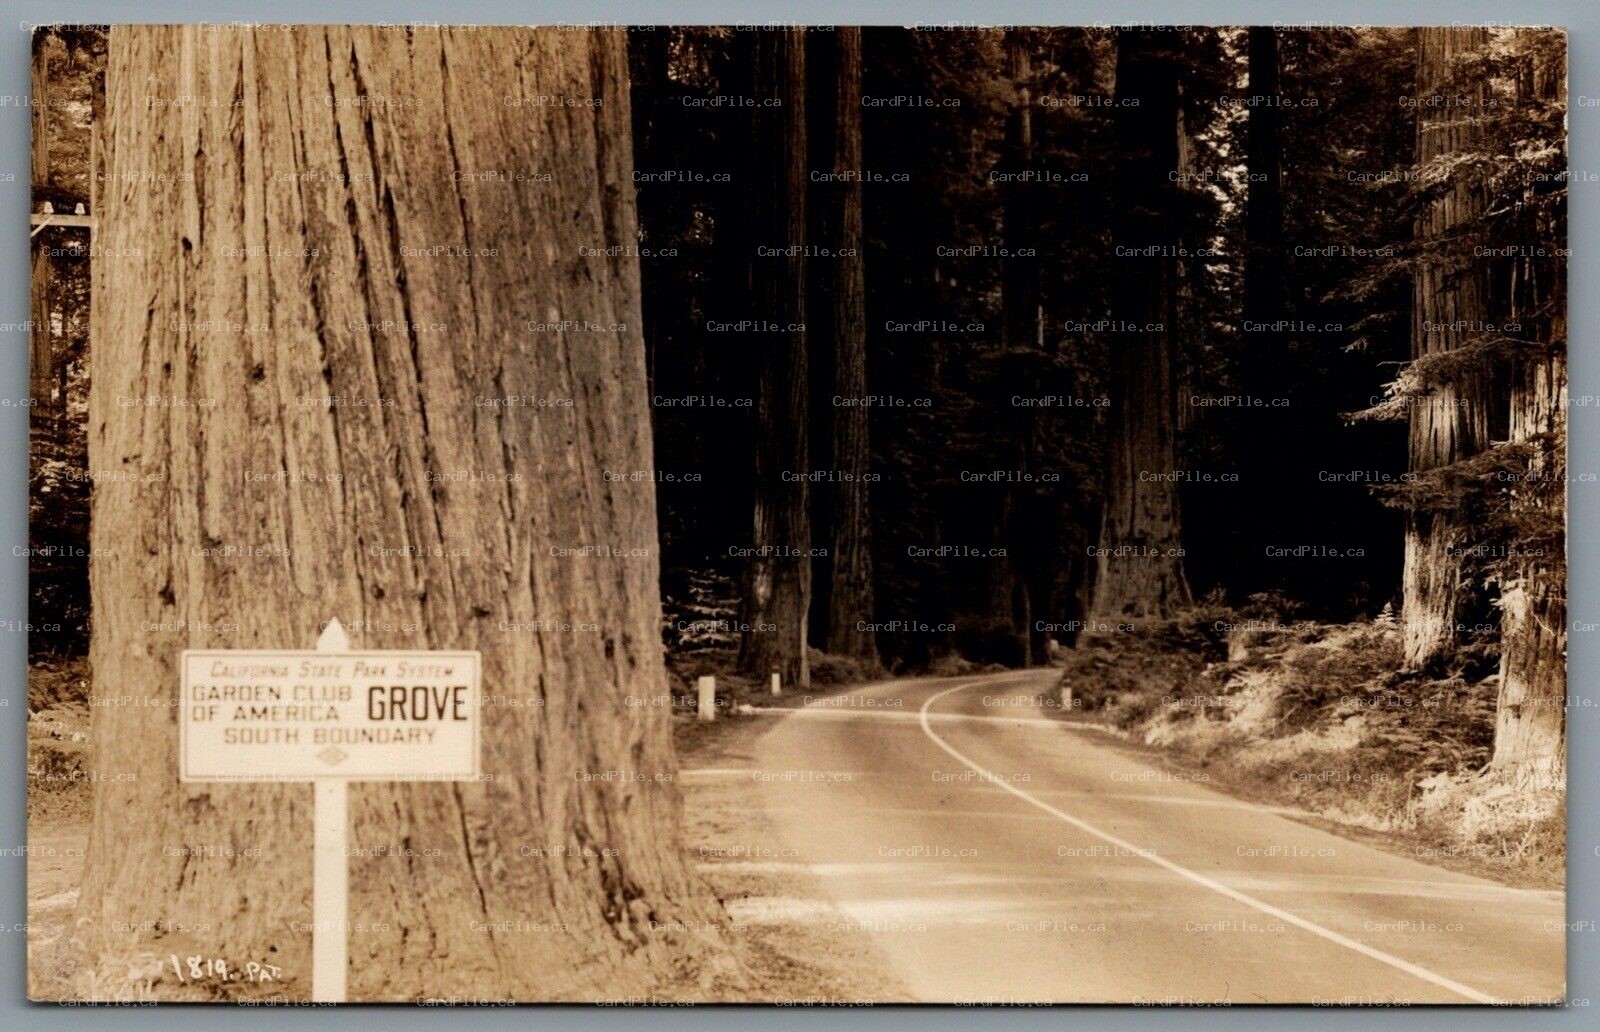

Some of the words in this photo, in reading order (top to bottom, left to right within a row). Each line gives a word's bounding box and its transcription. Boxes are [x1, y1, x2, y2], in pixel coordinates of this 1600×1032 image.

[299, 661, 342, 678] STATE
[353, 661, 386, 677] PARK
[192, 685, 281, 701] GARDEN
[293, 685, 352, 701] CLUB
[367, 685, 468, 721] GROVE
[192, 705, 219, 722] OF
[233, 705, 340, 722] AMERICA
[224, 727, 299, 745] SOUTH
[313, 727, 437, 745] BOUNDARY
